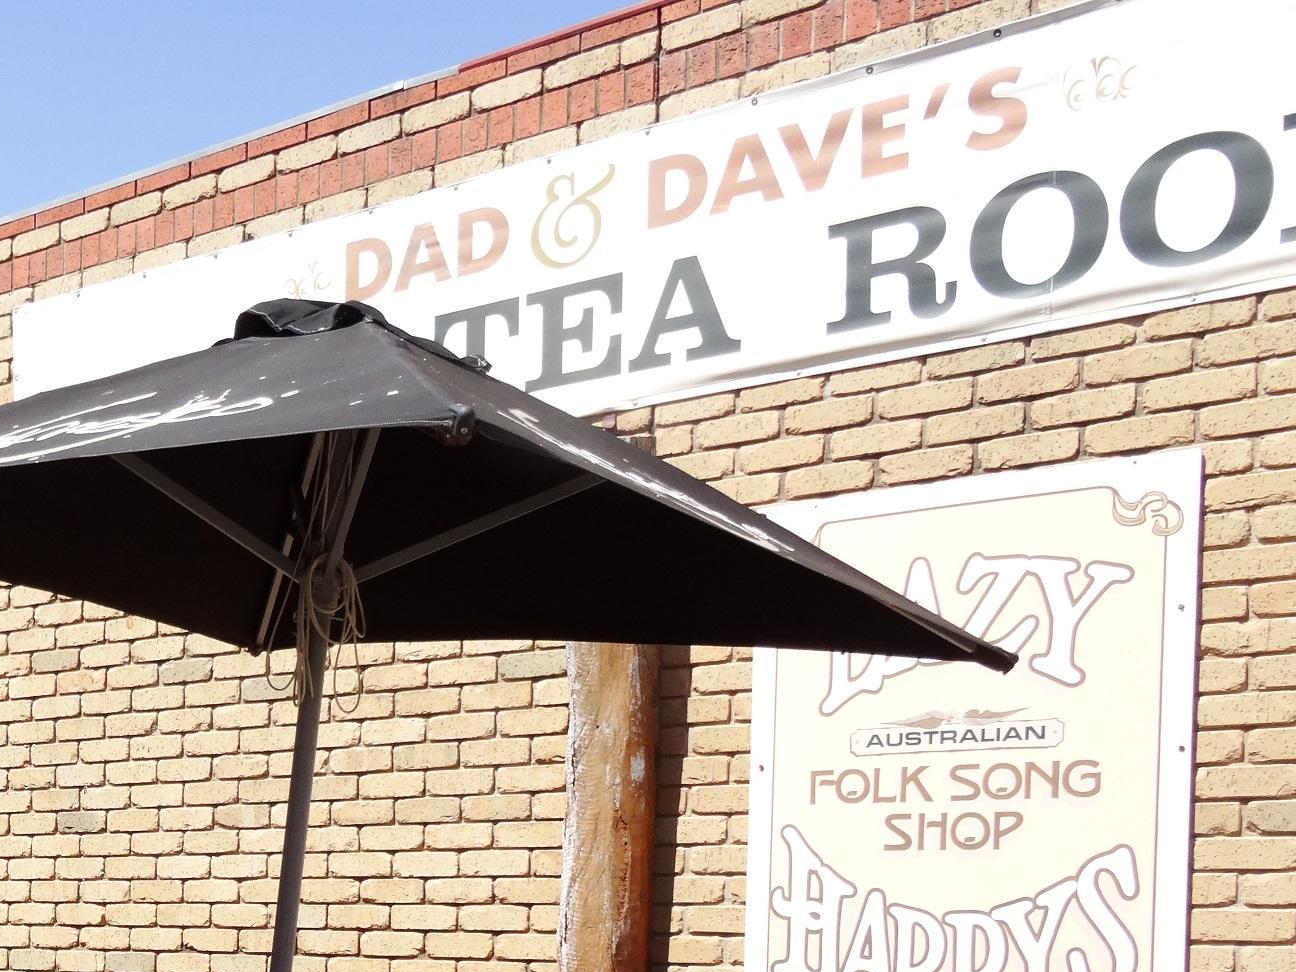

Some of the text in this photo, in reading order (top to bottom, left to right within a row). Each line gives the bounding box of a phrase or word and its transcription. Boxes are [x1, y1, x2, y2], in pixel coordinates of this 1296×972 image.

[345, 66, 1028, 302] DAD & DAVE'S
[434, 112, 1296, 392] TEA ROO
[865, 725, 1047, 750] AUSTRALIAN
[809, 759, 1103, 805] FOLK SONG
[883, 811, 1024, 852] SHOP
